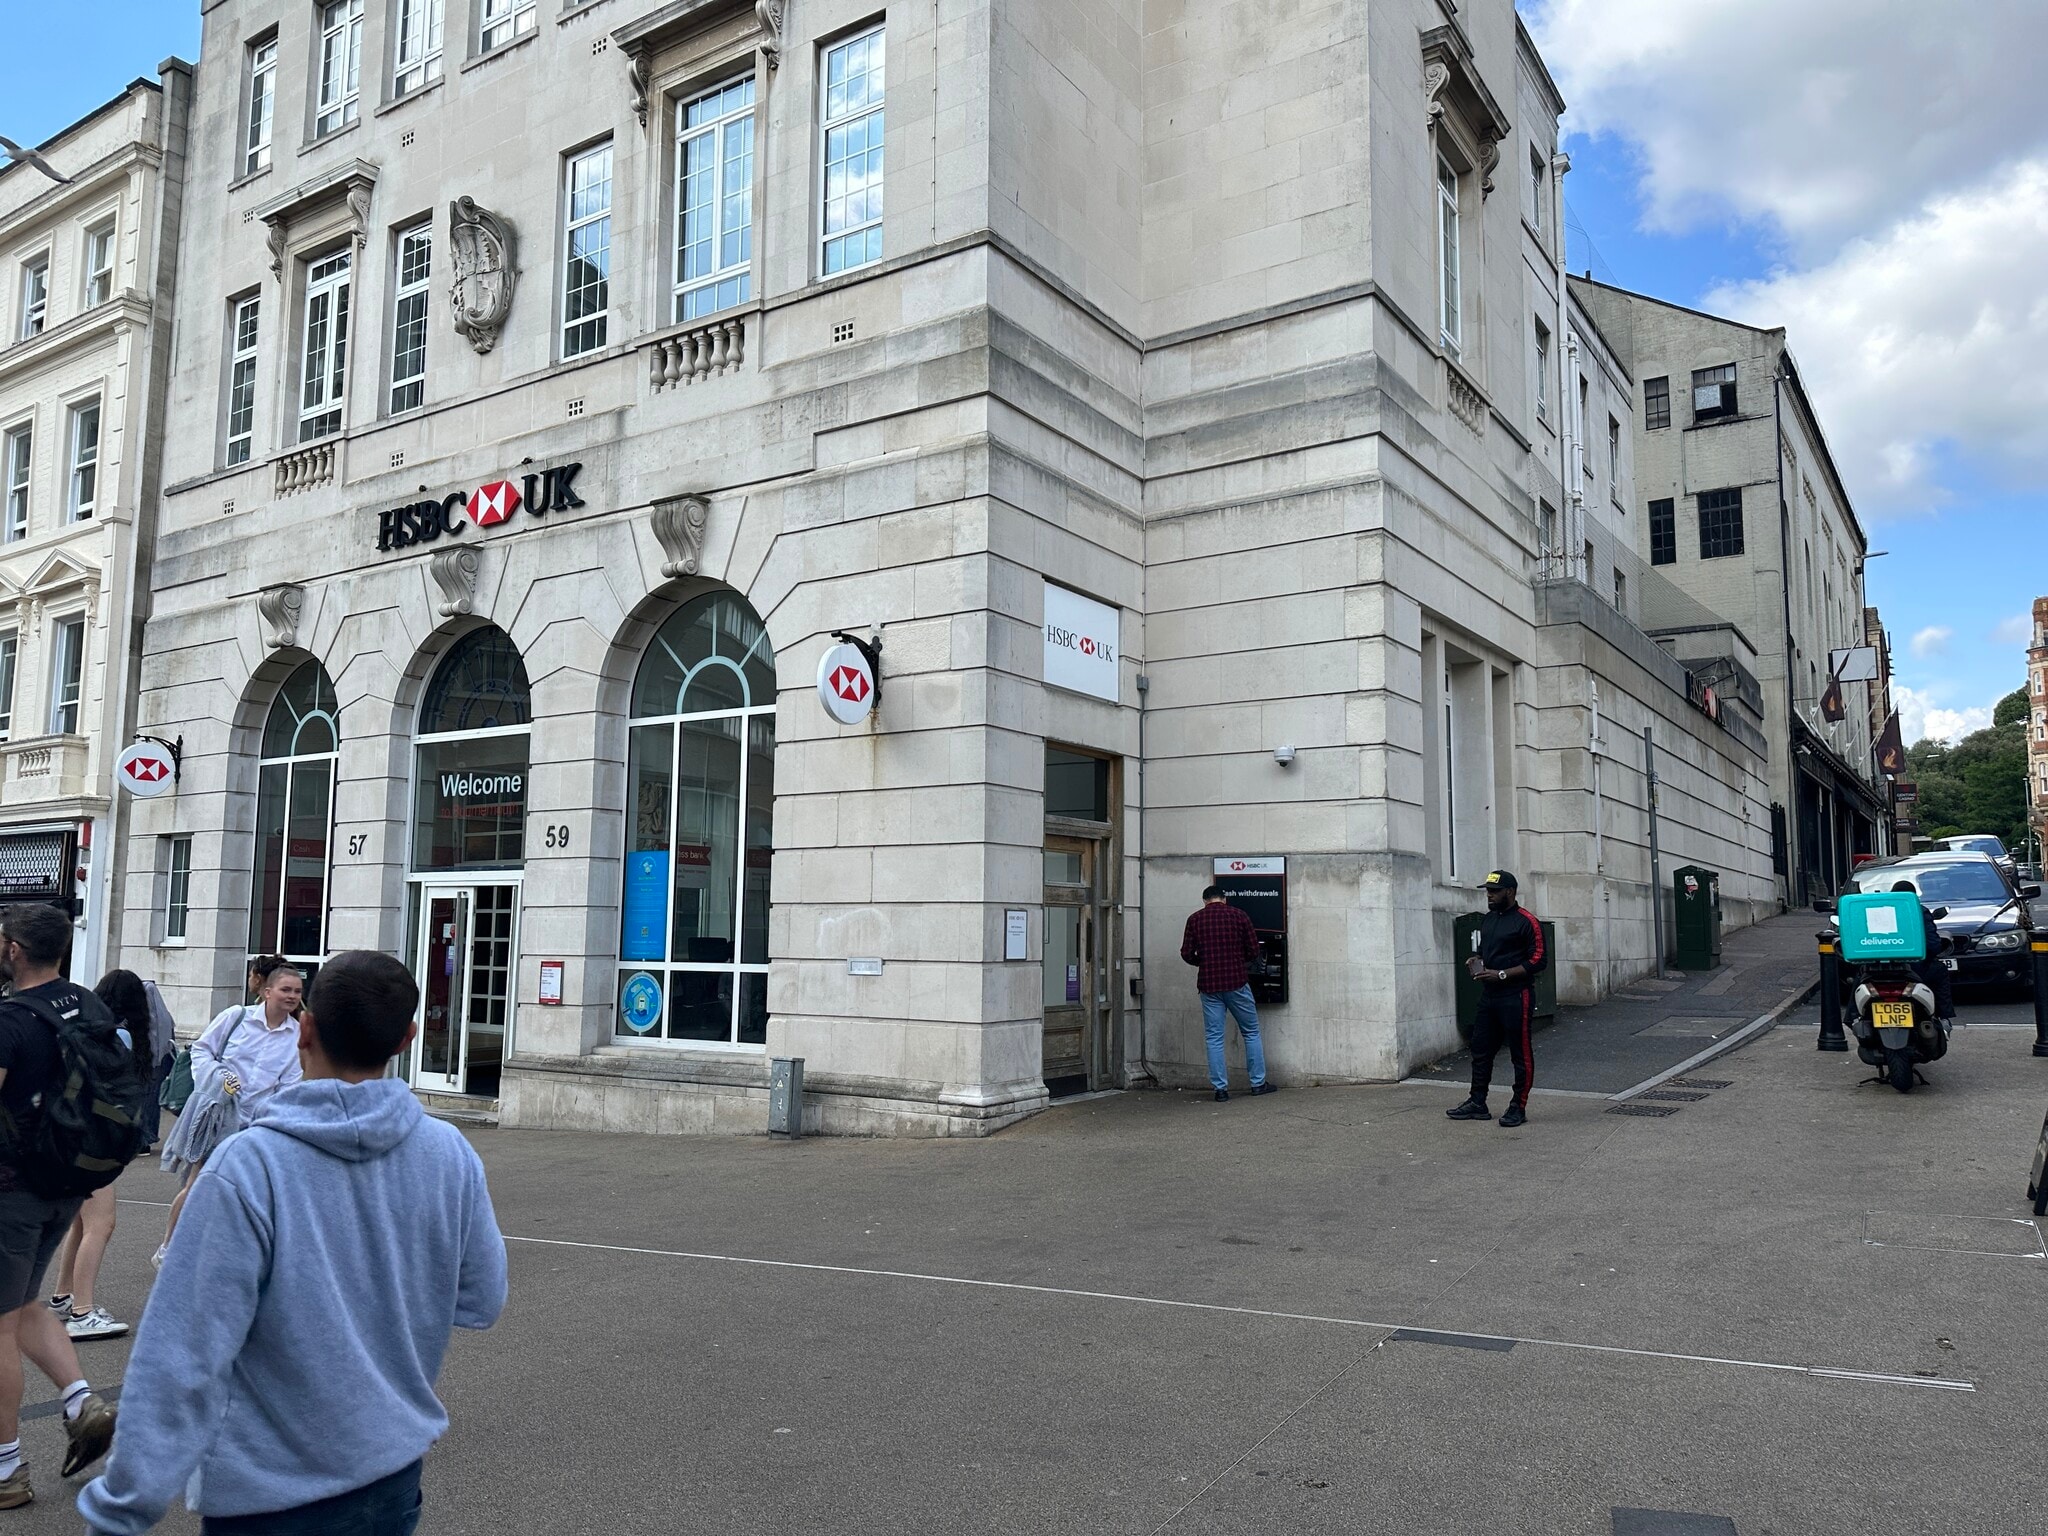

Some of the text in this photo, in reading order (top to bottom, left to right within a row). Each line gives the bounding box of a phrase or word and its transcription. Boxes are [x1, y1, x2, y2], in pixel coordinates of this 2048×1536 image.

[376, 463, 585, 551] HSBC UK
[1047, 624, 1113, 662] HSBC UK
[441, 773, 522, 798] Welcome
[348, 834, 368, 855] 57
[545, 825, 570, 848] 59
[1238, 889, 1279, 897] withdrawals
[1860, 937, 1905, 946] deliveroo
[1874, 1004, 1911, 1015] LO66
[1880, 1015, 1907, 1025] LNP
